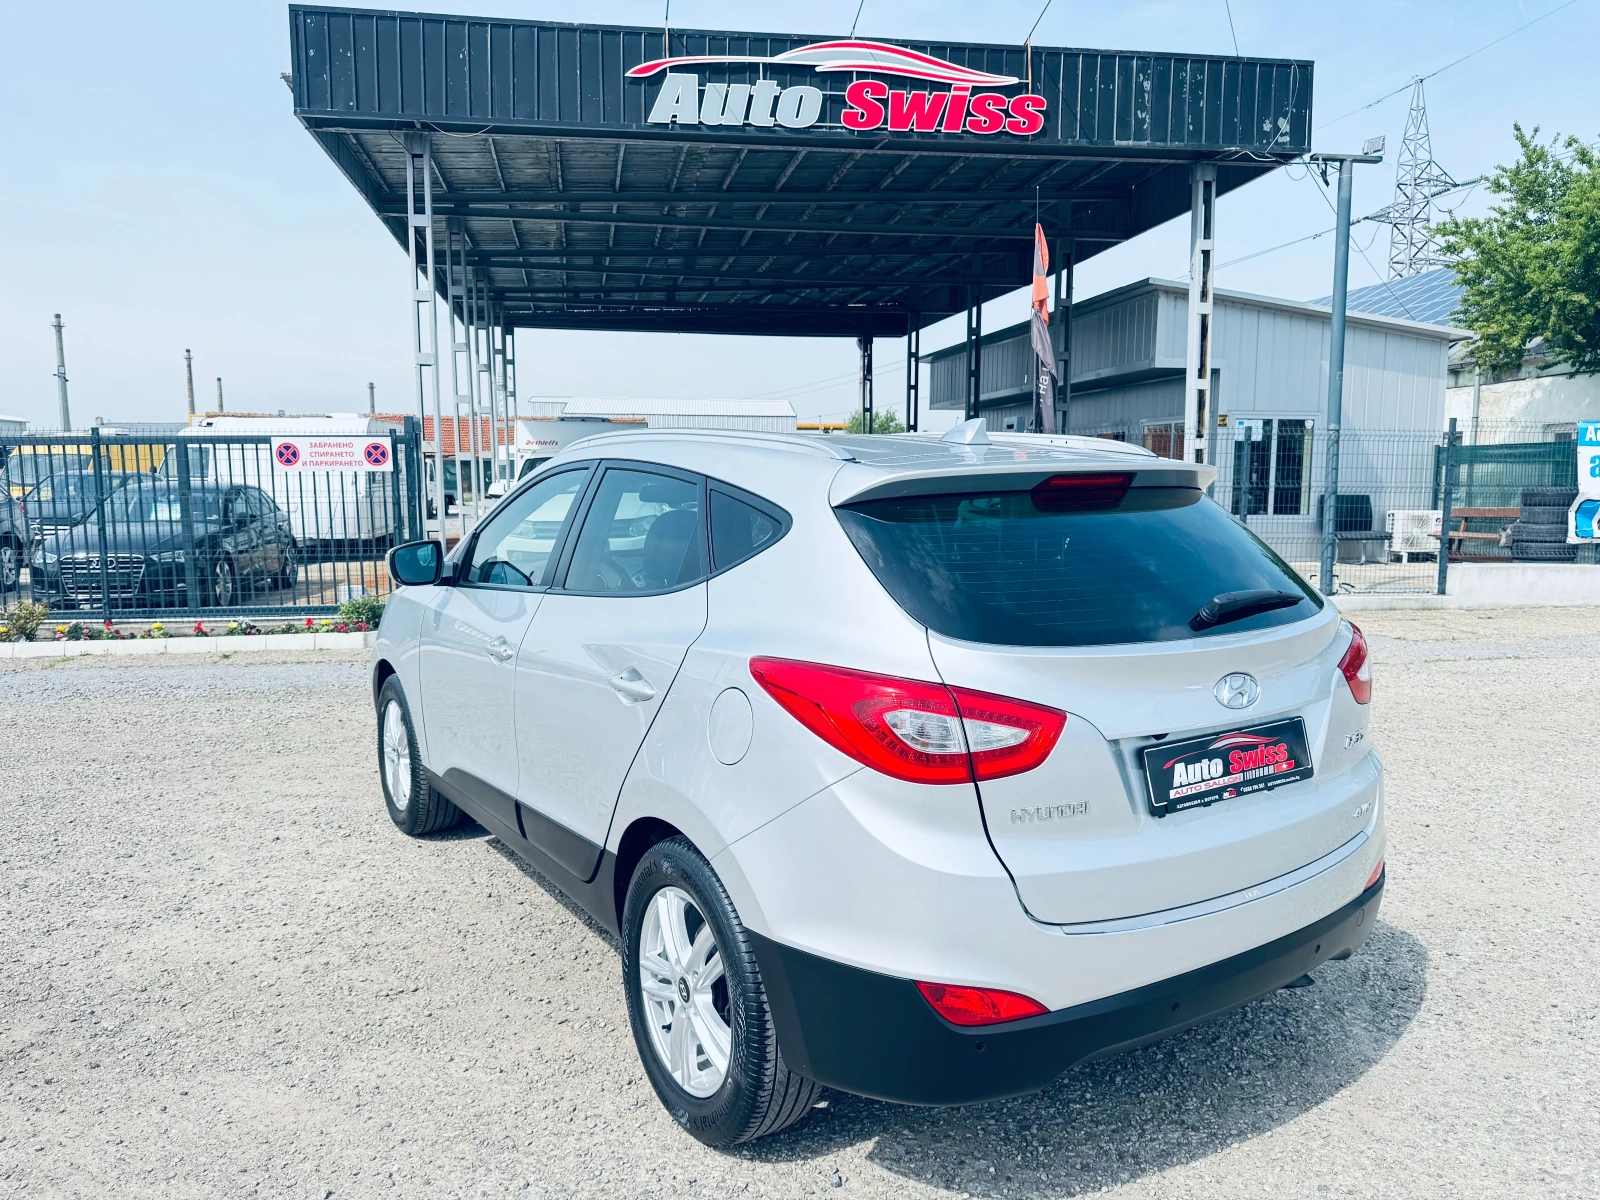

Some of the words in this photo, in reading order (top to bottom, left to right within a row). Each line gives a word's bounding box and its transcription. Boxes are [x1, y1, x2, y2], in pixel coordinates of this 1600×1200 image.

[647, 73, 822, 128] Auto
[841, 80, 1046, 135] Swiss
[1172, 758, 1224, 787] Auto
[1229, 743, 1288, 773] Swiss
[1173, 785, 1202, 797] AUTO
[1204, 775, 1242, 789] SALLON
[1010, 800, 1089, 824] HYUNDAI
